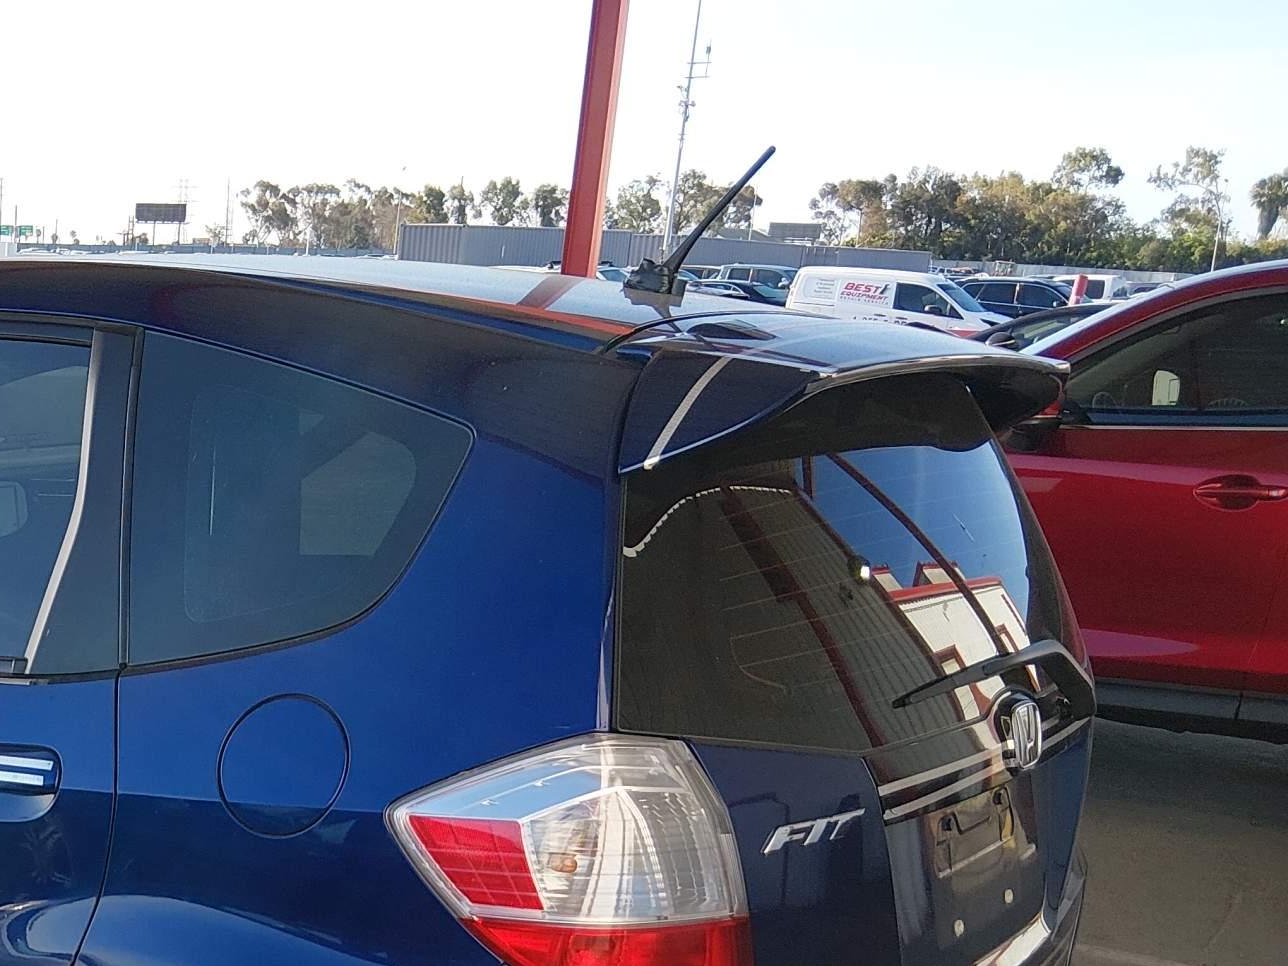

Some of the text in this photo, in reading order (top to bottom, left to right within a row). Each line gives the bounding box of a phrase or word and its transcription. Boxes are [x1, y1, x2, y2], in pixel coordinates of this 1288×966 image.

[843, 282, 882, 294] BEST
[840, 290, 888, 301] EQUIPMENT
[761, 808, 865, 855] FIT
